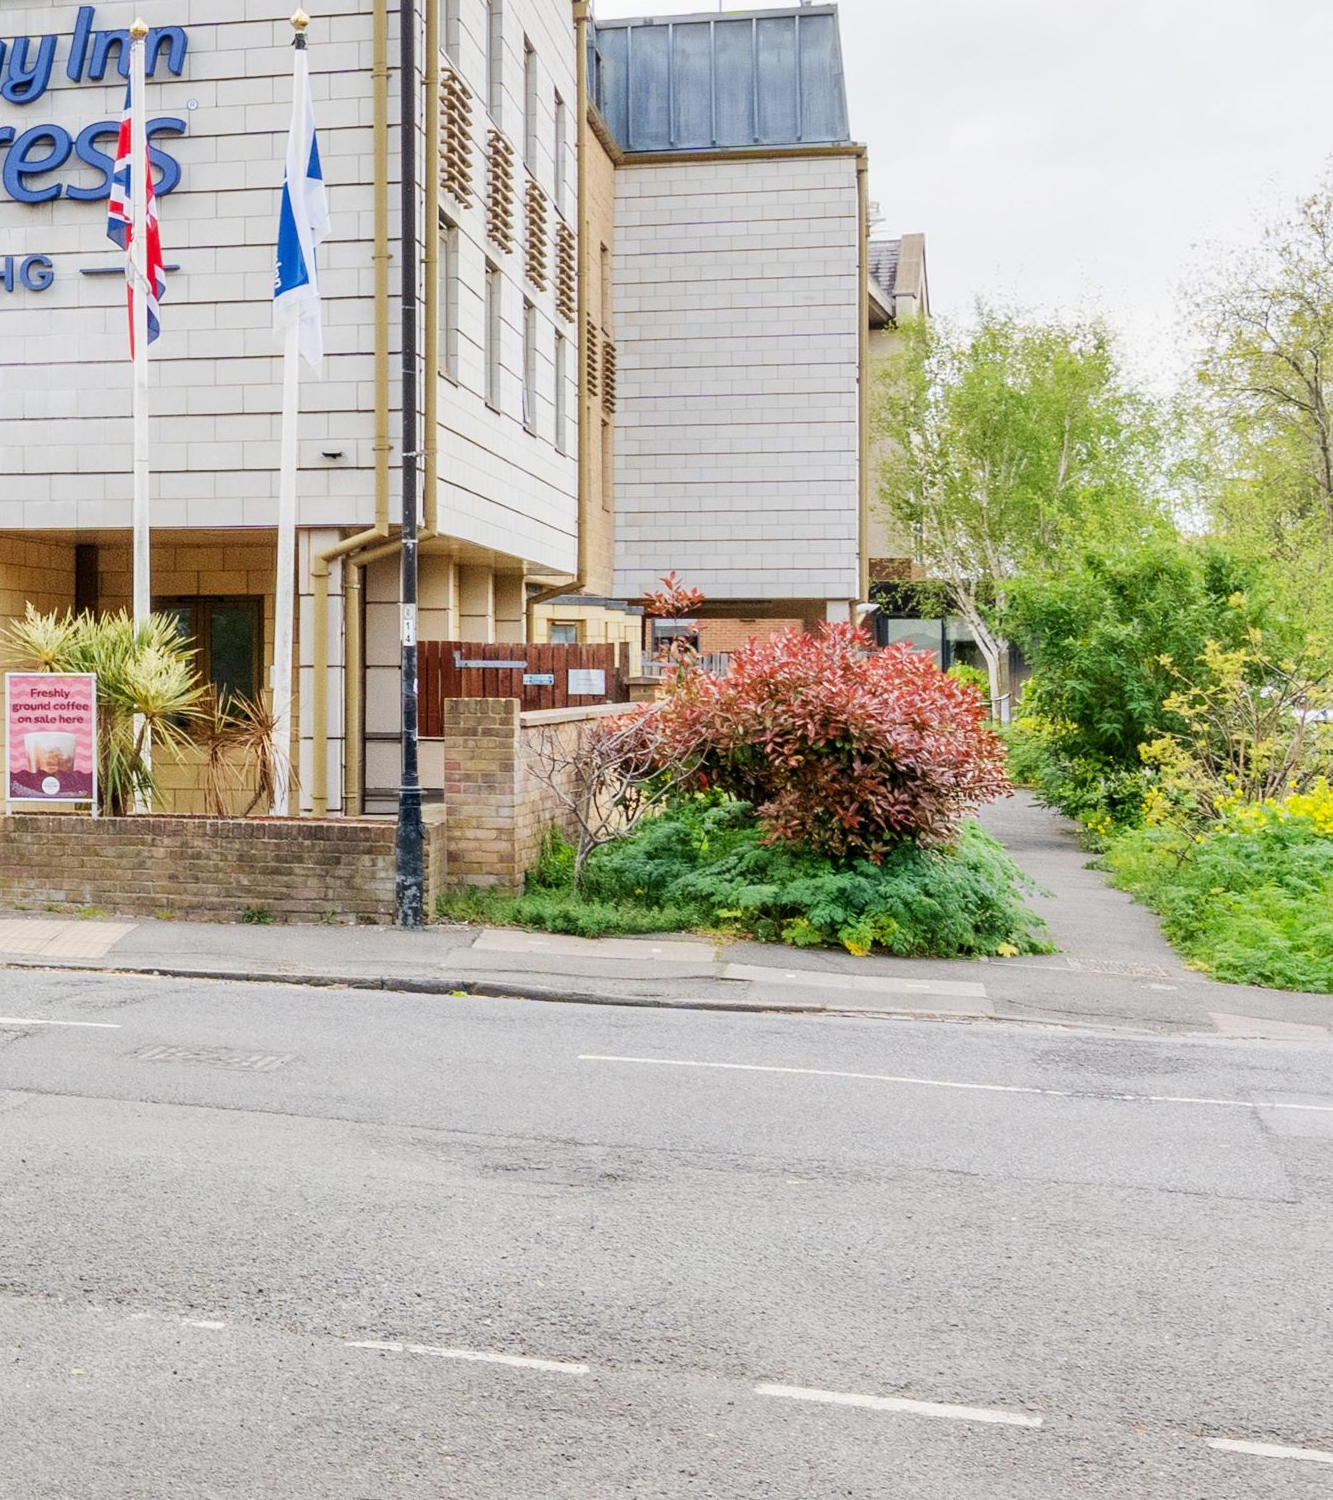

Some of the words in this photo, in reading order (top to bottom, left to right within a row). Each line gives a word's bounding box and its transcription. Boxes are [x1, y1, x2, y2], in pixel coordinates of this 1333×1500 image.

[66, 6, 188, 82] Inn
[30, 688, 70, 700] Freshly
[12, 701, 51, 713] ground
[53, 701, 89, 711] coffee
[17, 716, 32, 724] on
[34, 714, 57, 724] sale
[59, 714, 84, 724] here
